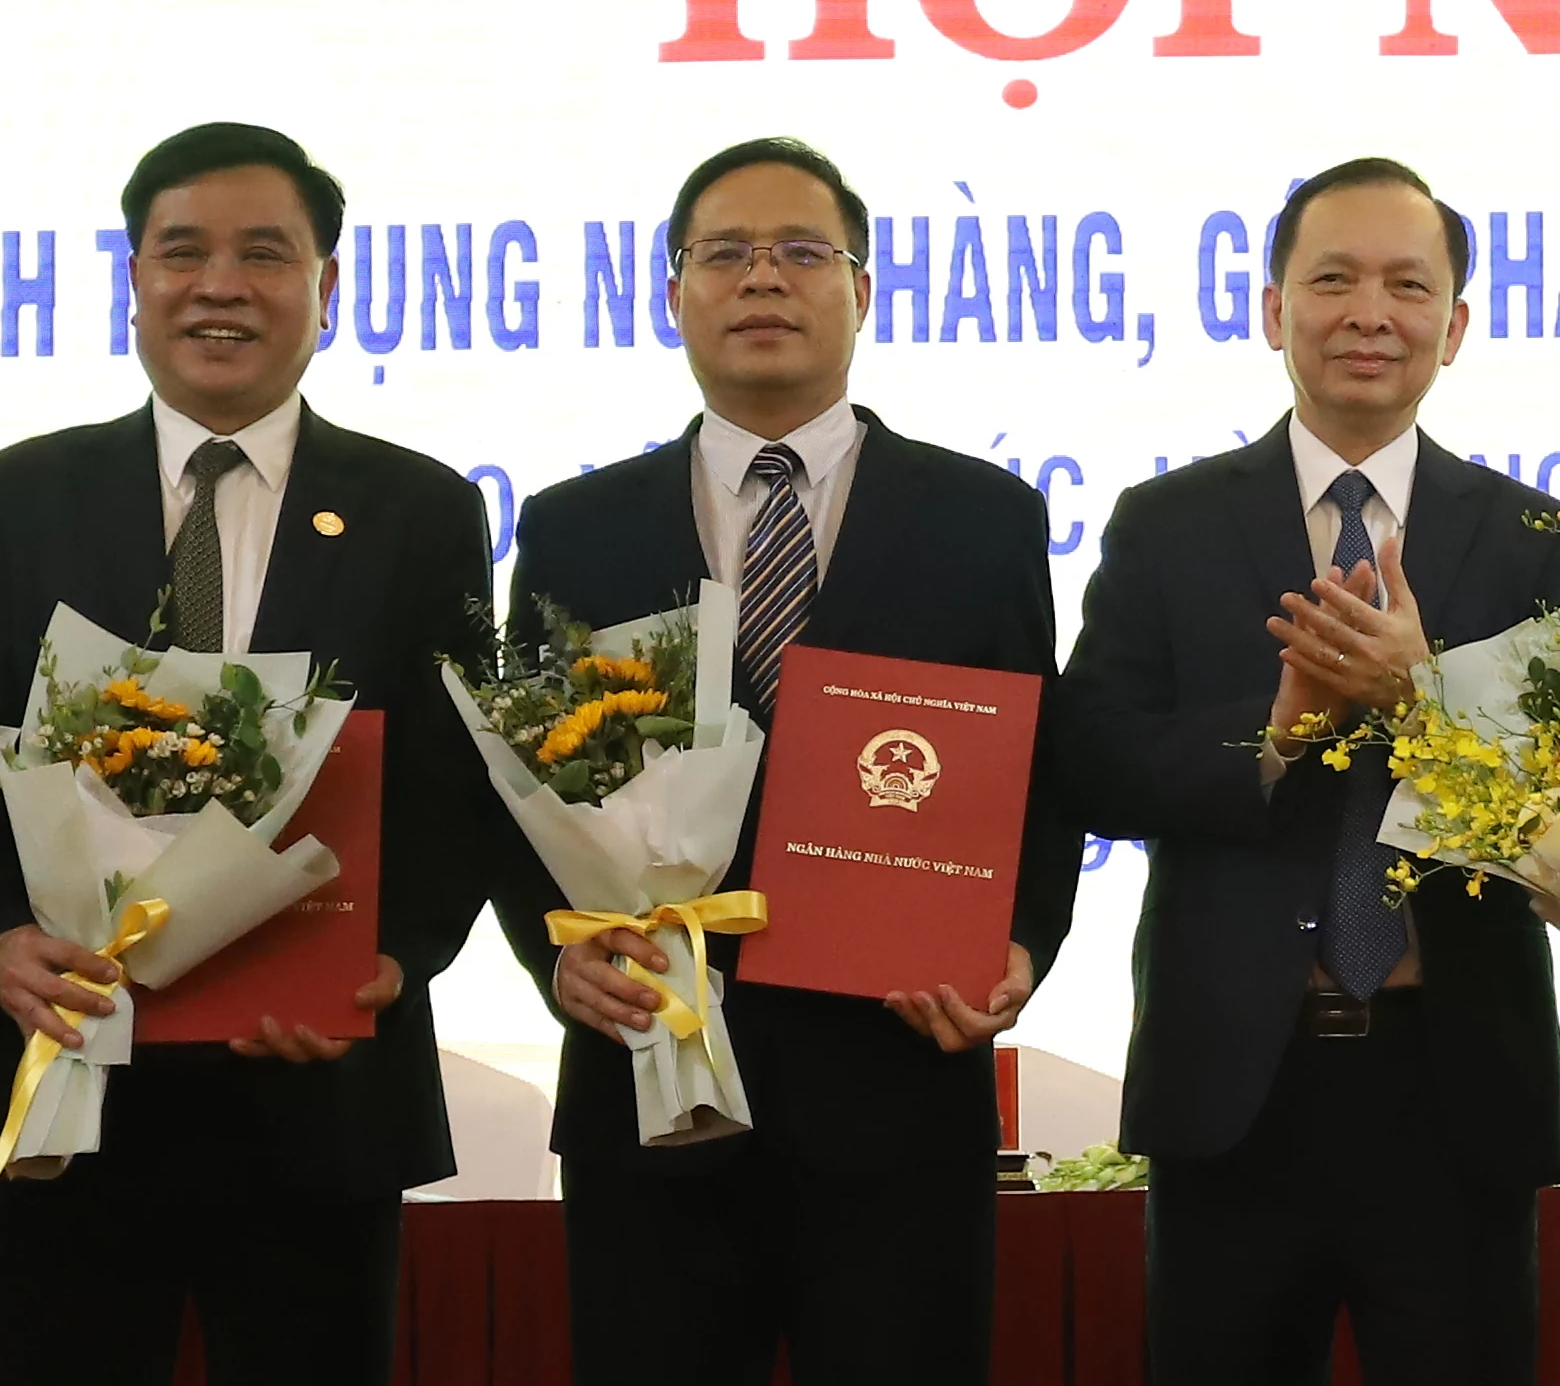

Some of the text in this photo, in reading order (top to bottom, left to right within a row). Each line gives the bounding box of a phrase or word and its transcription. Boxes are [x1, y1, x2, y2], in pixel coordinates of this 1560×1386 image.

[875, 180, 1157, 368] HÀNG,
[823, 685, 849, 696] CỘNG
[884, 691, 901, 704] HỘI
[953, 701, 975, 712] VIỆT
[976, 704, 997, 714] NAM
[786, 842, 994, 879] NGÂN HÀNG NHÀ NƯỚC VIỆT NAM
